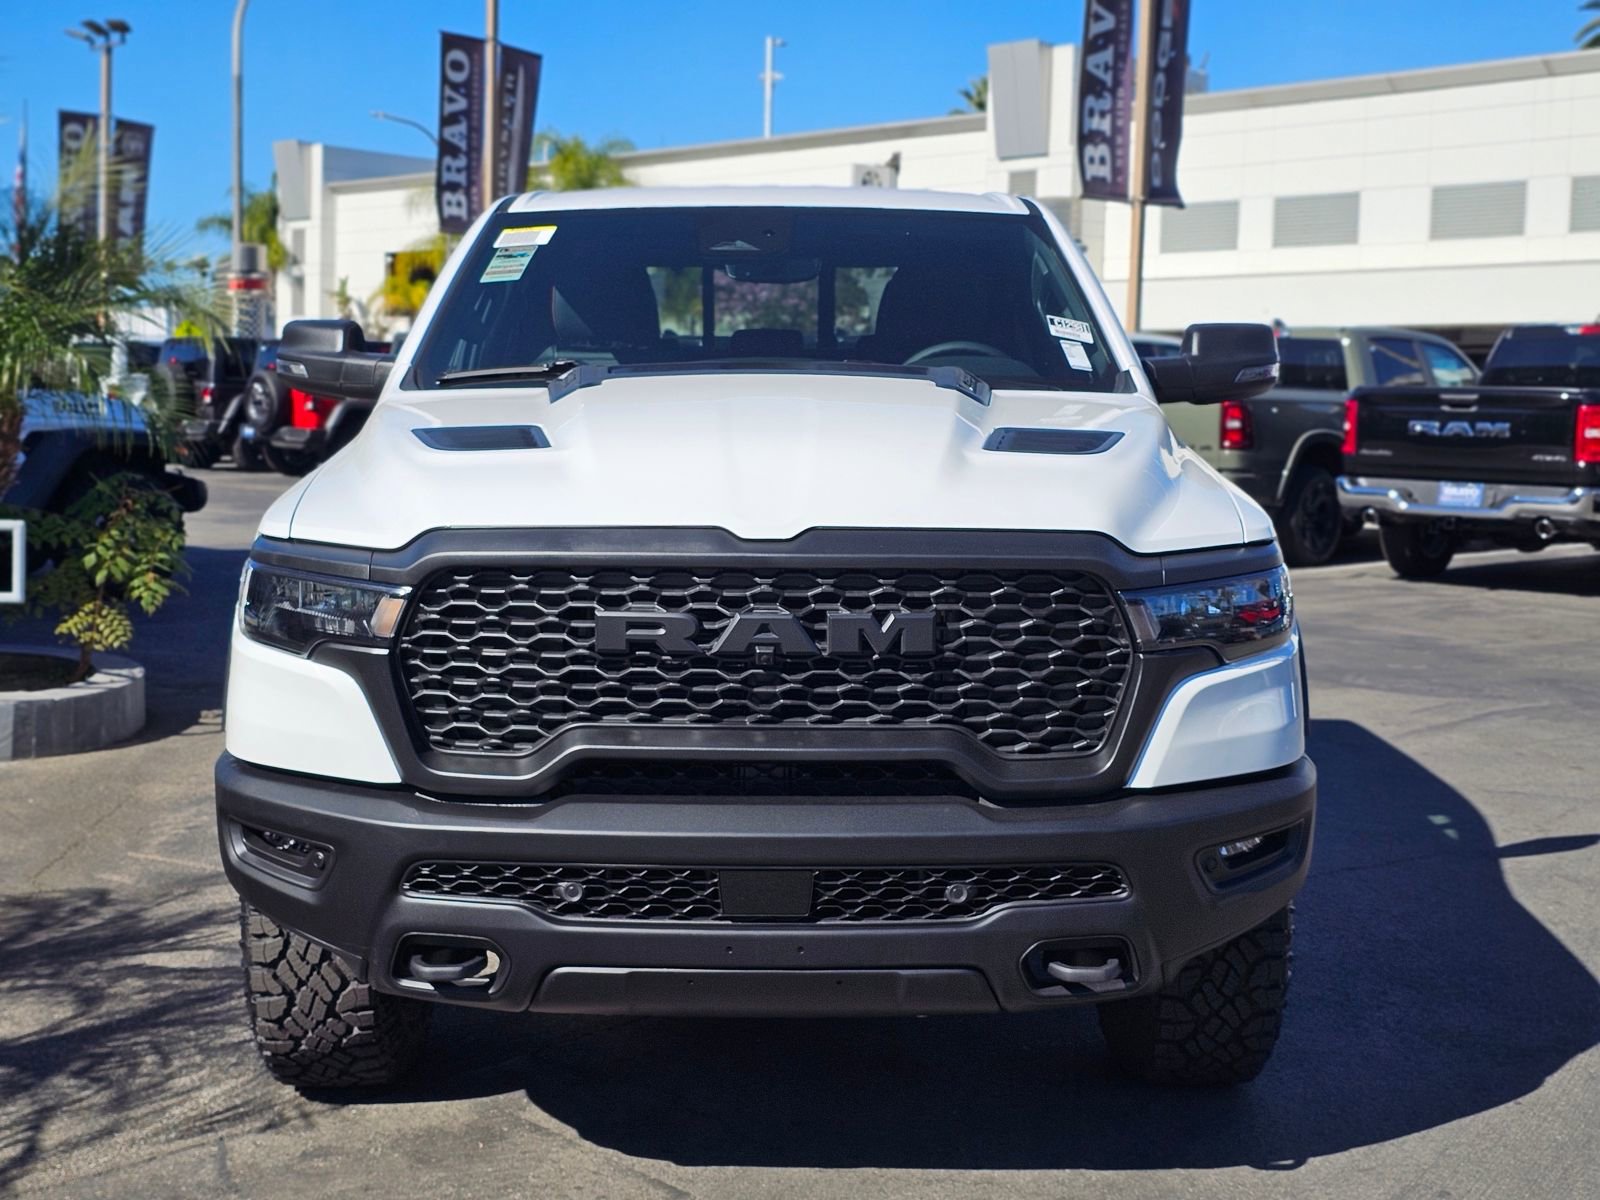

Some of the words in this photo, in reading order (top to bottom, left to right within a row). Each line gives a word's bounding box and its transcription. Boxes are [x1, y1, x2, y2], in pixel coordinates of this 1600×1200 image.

[442, 48, 471, 221] BRAVO
[1408, 420, 1511, 438] RAM
[595, 609, 936, 656] RAM
